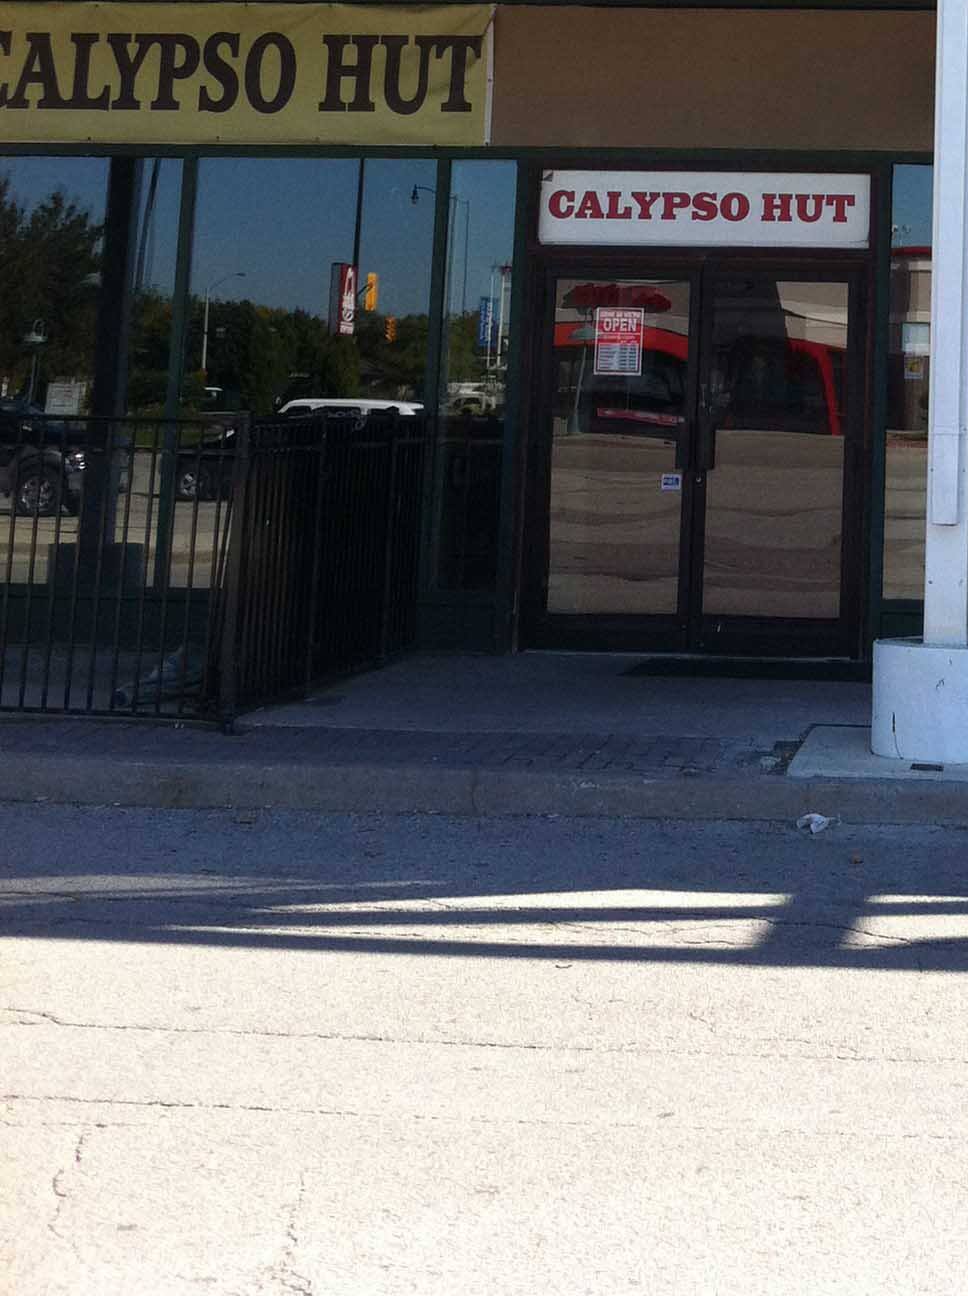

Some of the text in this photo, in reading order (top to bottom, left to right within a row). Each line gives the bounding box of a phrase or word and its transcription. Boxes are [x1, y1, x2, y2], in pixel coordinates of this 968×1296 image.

[0, 30, 481, 115] ALYPSO HUT
[548, 189, 855, 223] CALYPSO HUT
[603, 318, 637, 332] OPEN
